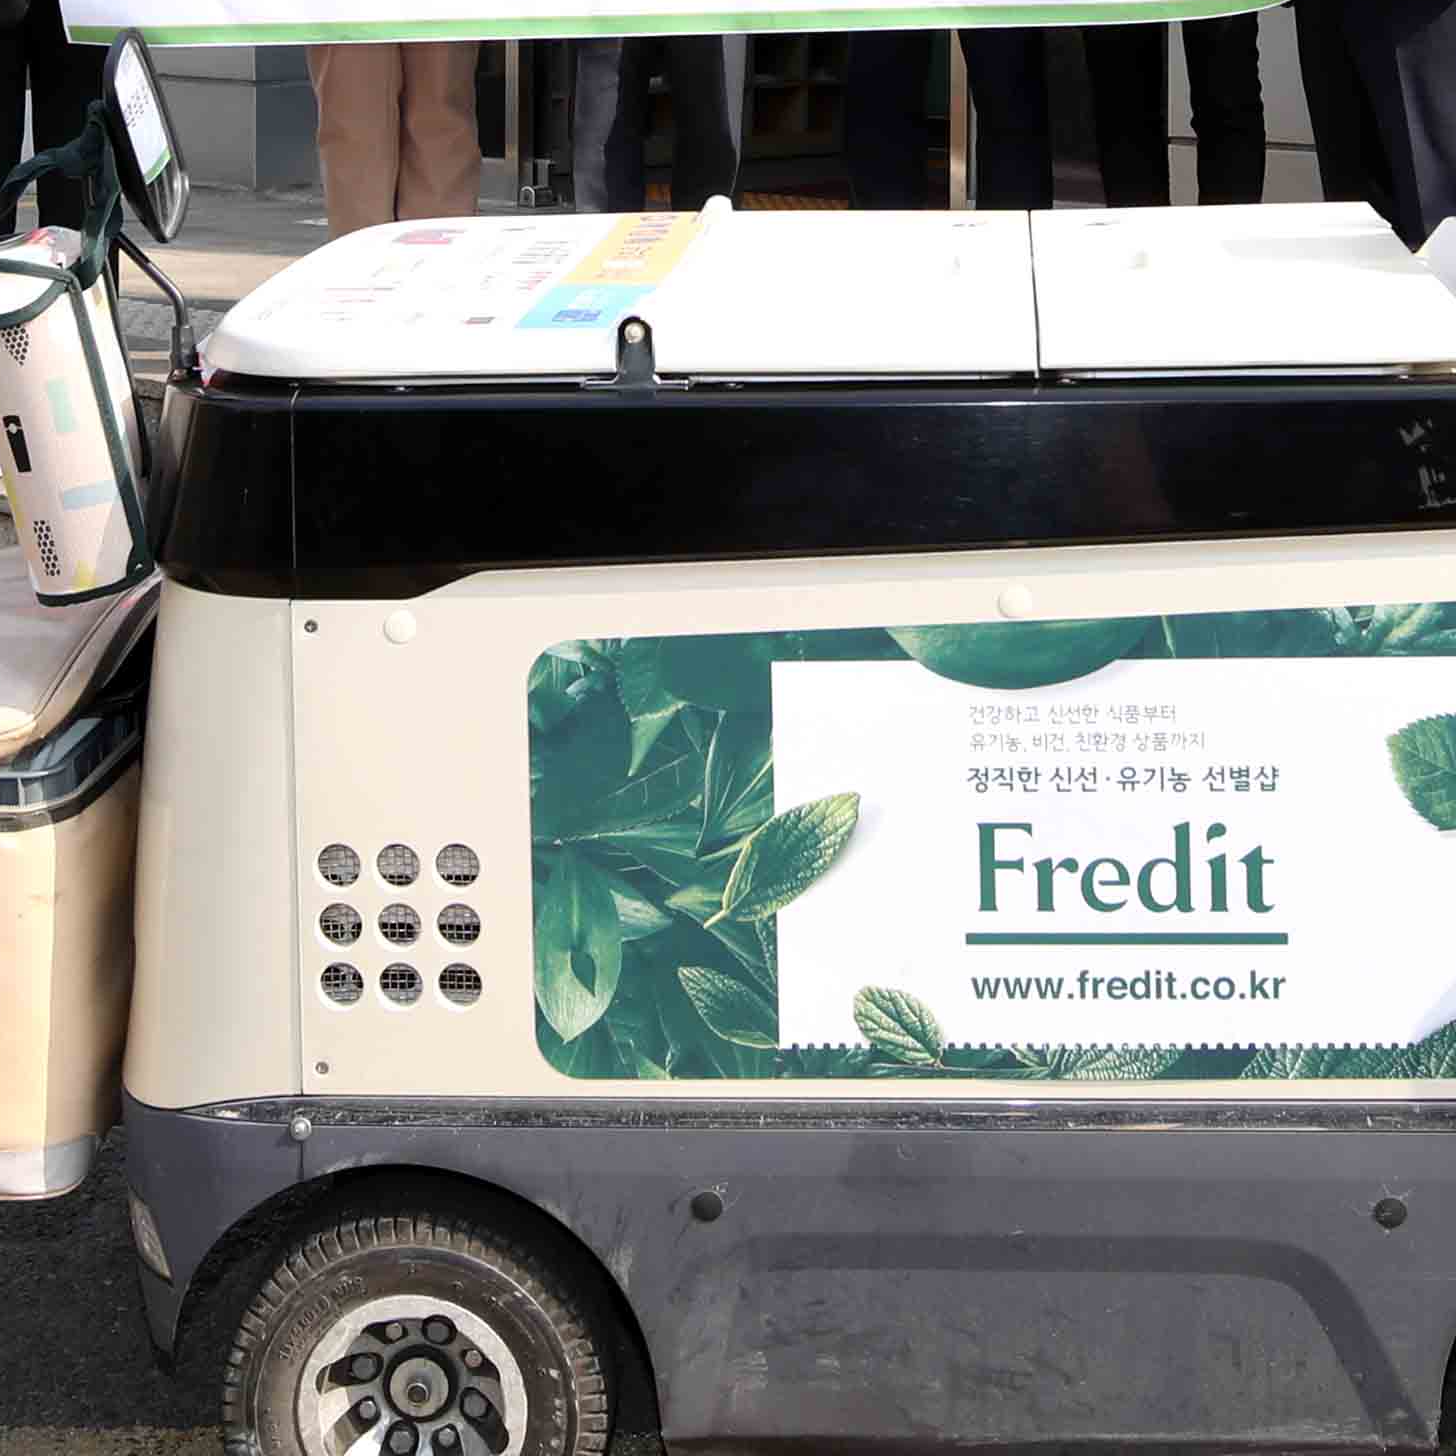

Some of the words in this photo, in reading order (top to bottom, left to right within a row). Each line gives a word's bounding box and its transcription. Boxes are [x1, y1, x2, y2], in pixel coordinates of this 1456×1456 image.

[968, 704, 1041, 725] 건강하고
[1048, 704, 1100, 725] 신선한
[1108, 704, 1177, 725] 식품부터
[1074, 732, 1127, 752] 친환경
[1133, 731, 1206, 753] 상품까지
[967, 766, 1042, 794] 정직한
[1201, 764, 1280, 794] 선별샵
[976, 821, 1276, 914] Fredit
[971, 969, 1287, 1001] www.fredit.co.kr
